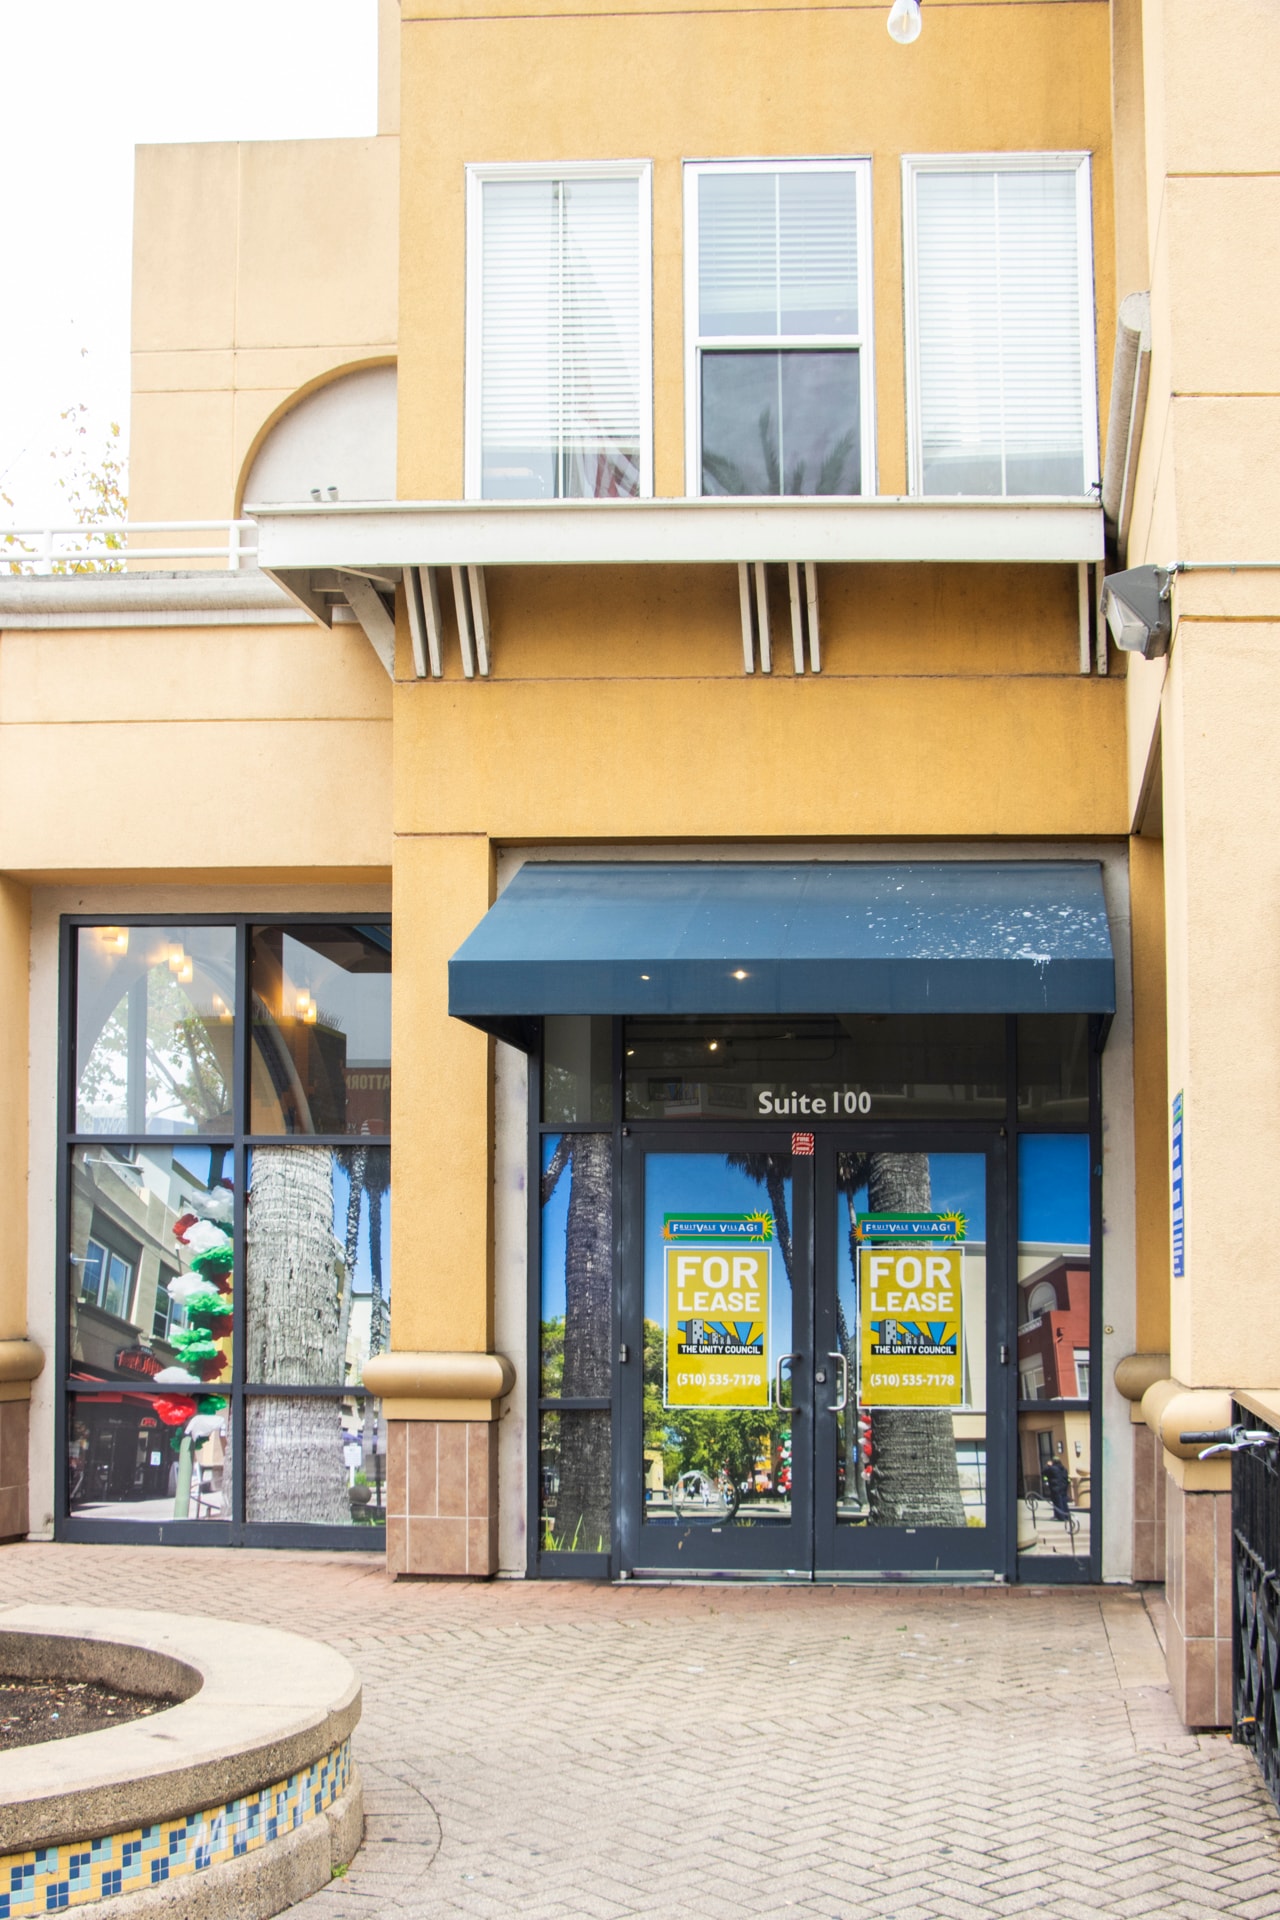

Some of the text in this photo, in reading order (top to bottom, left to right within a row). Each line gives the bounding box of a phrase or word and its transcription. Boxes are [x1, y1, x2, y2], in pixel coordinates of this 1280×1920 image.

[758, 1091, 872, 1114] Suite 100
[677, 1256, 759, 1289] FOR
[870, 1256, 952, 1289] FOR
[677, 1291, 760, 1312] LEASE
[871, 1291, 954, 1312] LEASE
[681, 1345, 761, 1354] THE UNITY COUNCIL
[874, 1345, 954, 1354] THE UNITY COUNCIL
[677, 1373, 761, 1387] (510) 535-7178
[870, 1373, 955, 1387] (510) 535-7178
